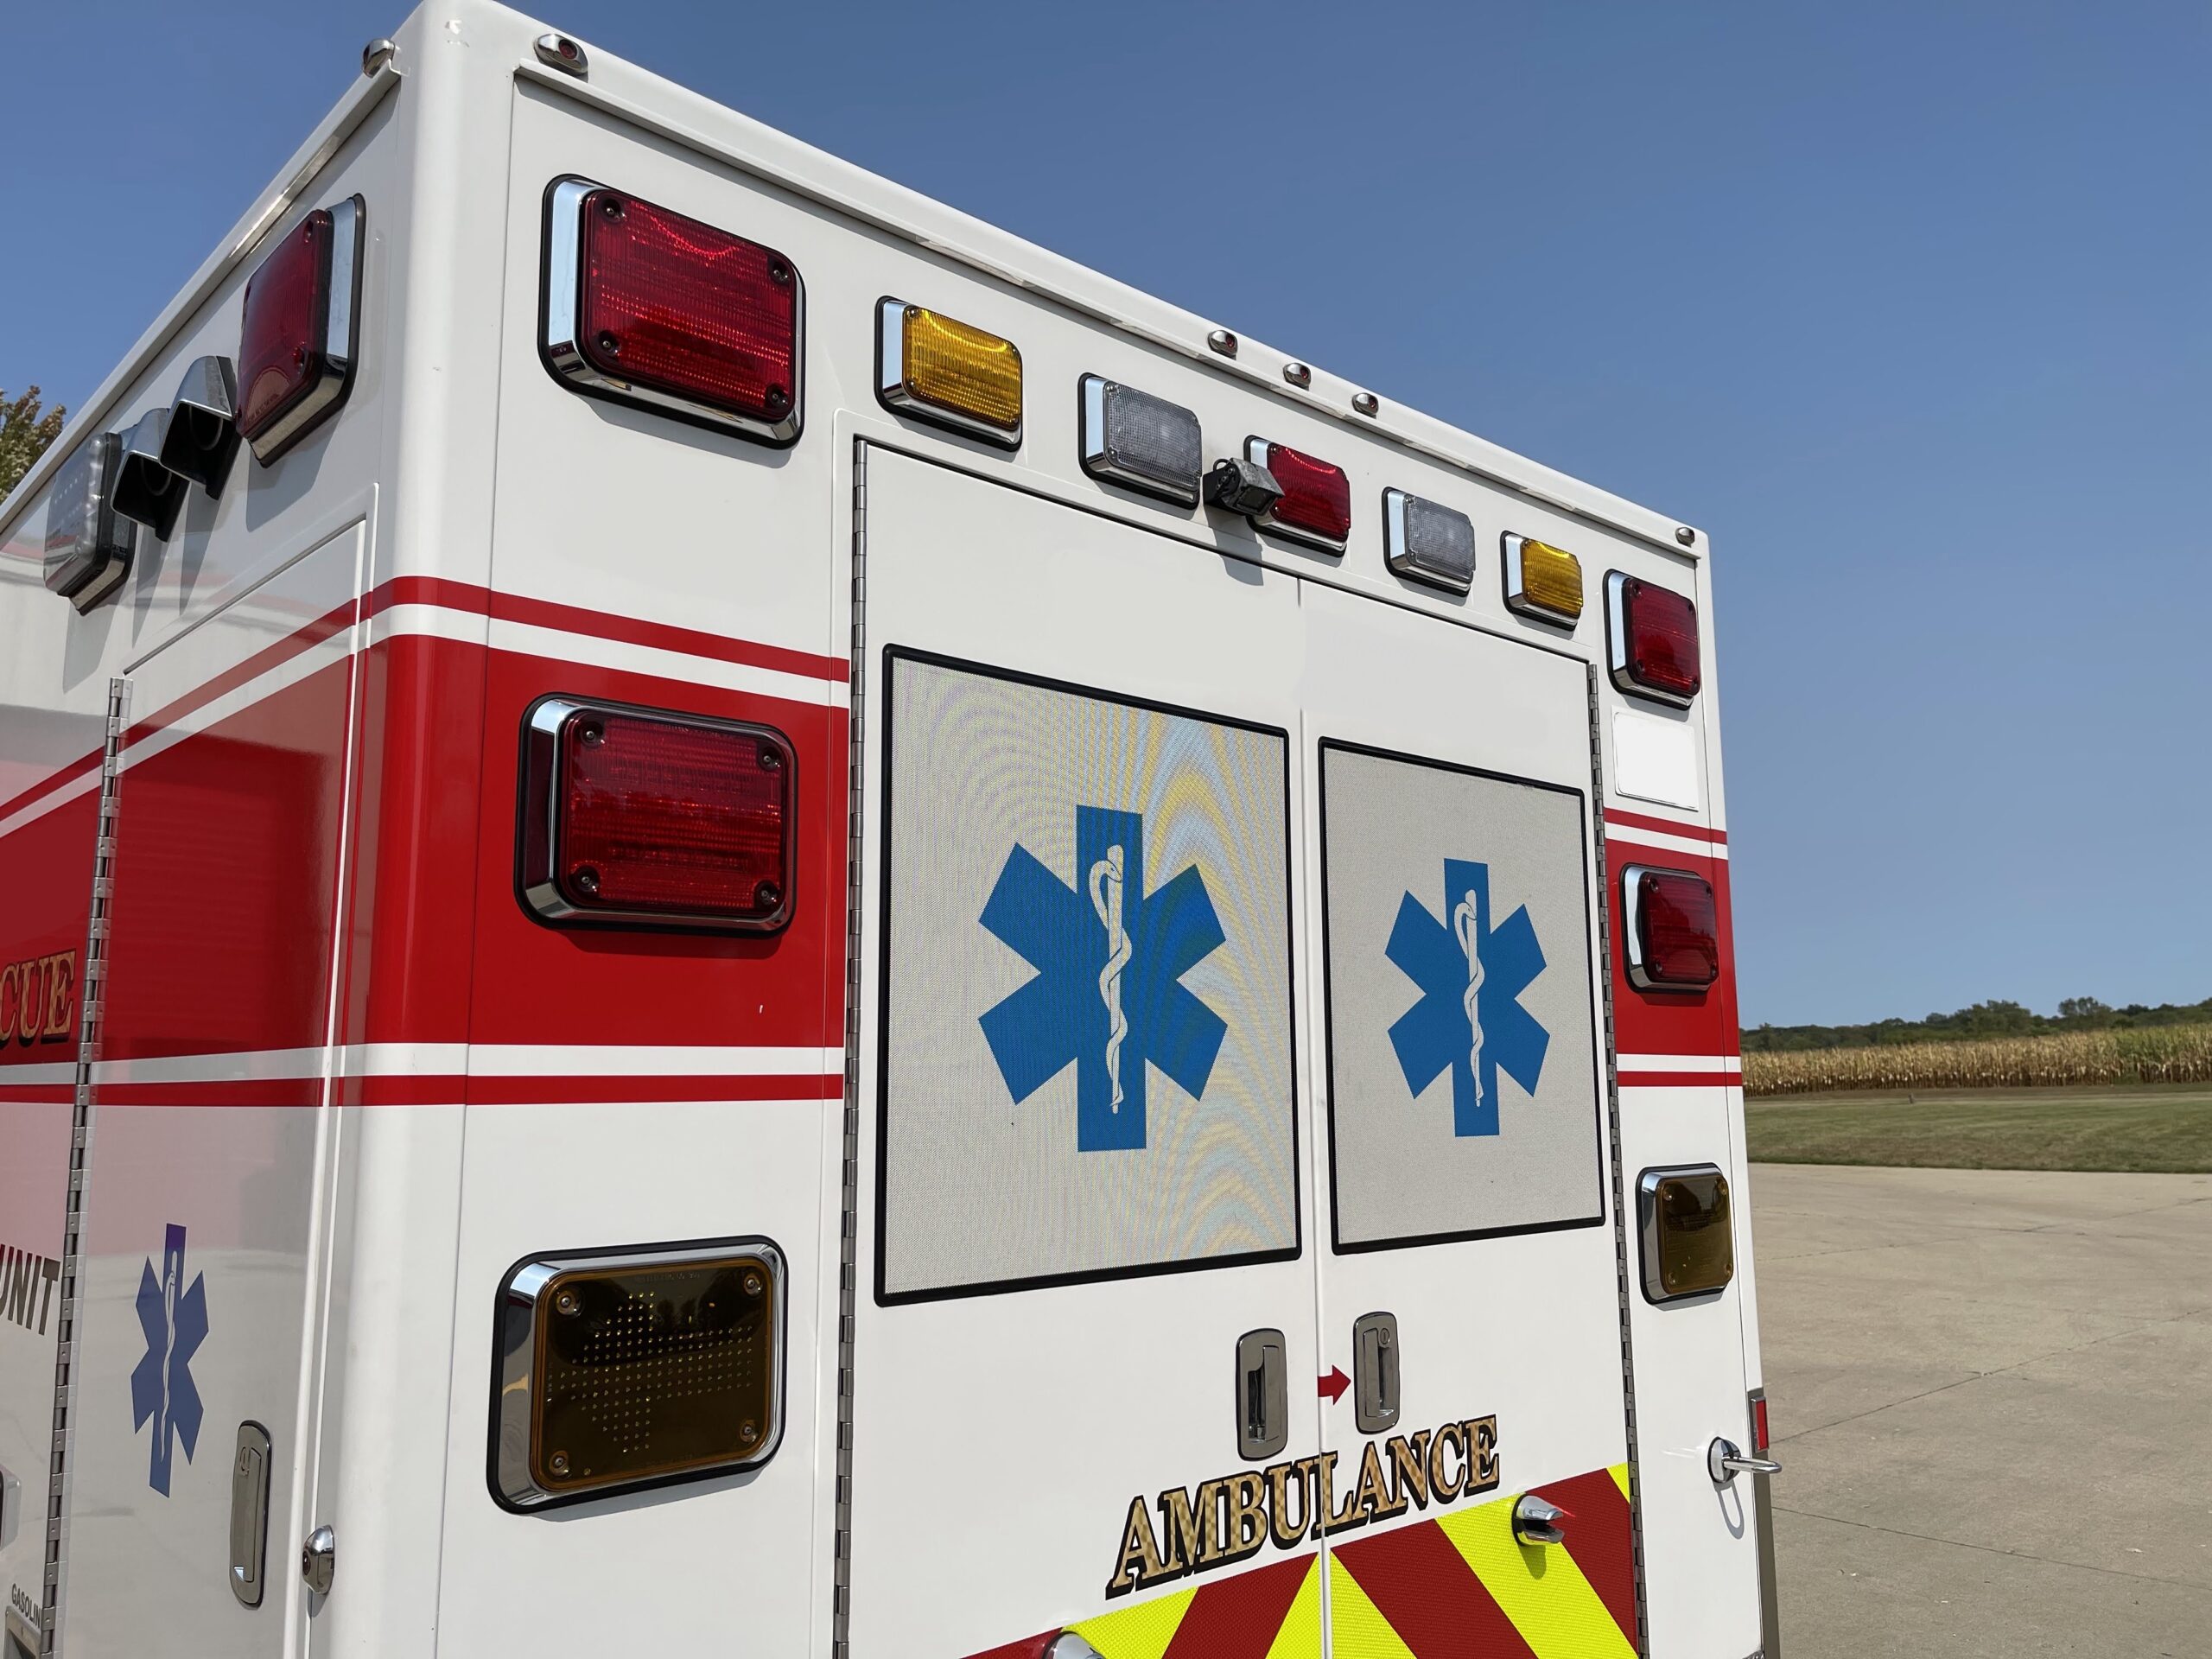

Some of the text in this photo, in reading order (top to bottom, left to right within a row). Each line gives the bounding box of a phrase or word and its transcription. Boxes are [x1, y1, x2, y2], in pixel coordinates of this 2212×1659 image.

[0, 949, 76, 1048] CUE
[0, 1243, 60, 1336] UNIT
[1105, 1414, 1499, 1599] AMBULANCE
